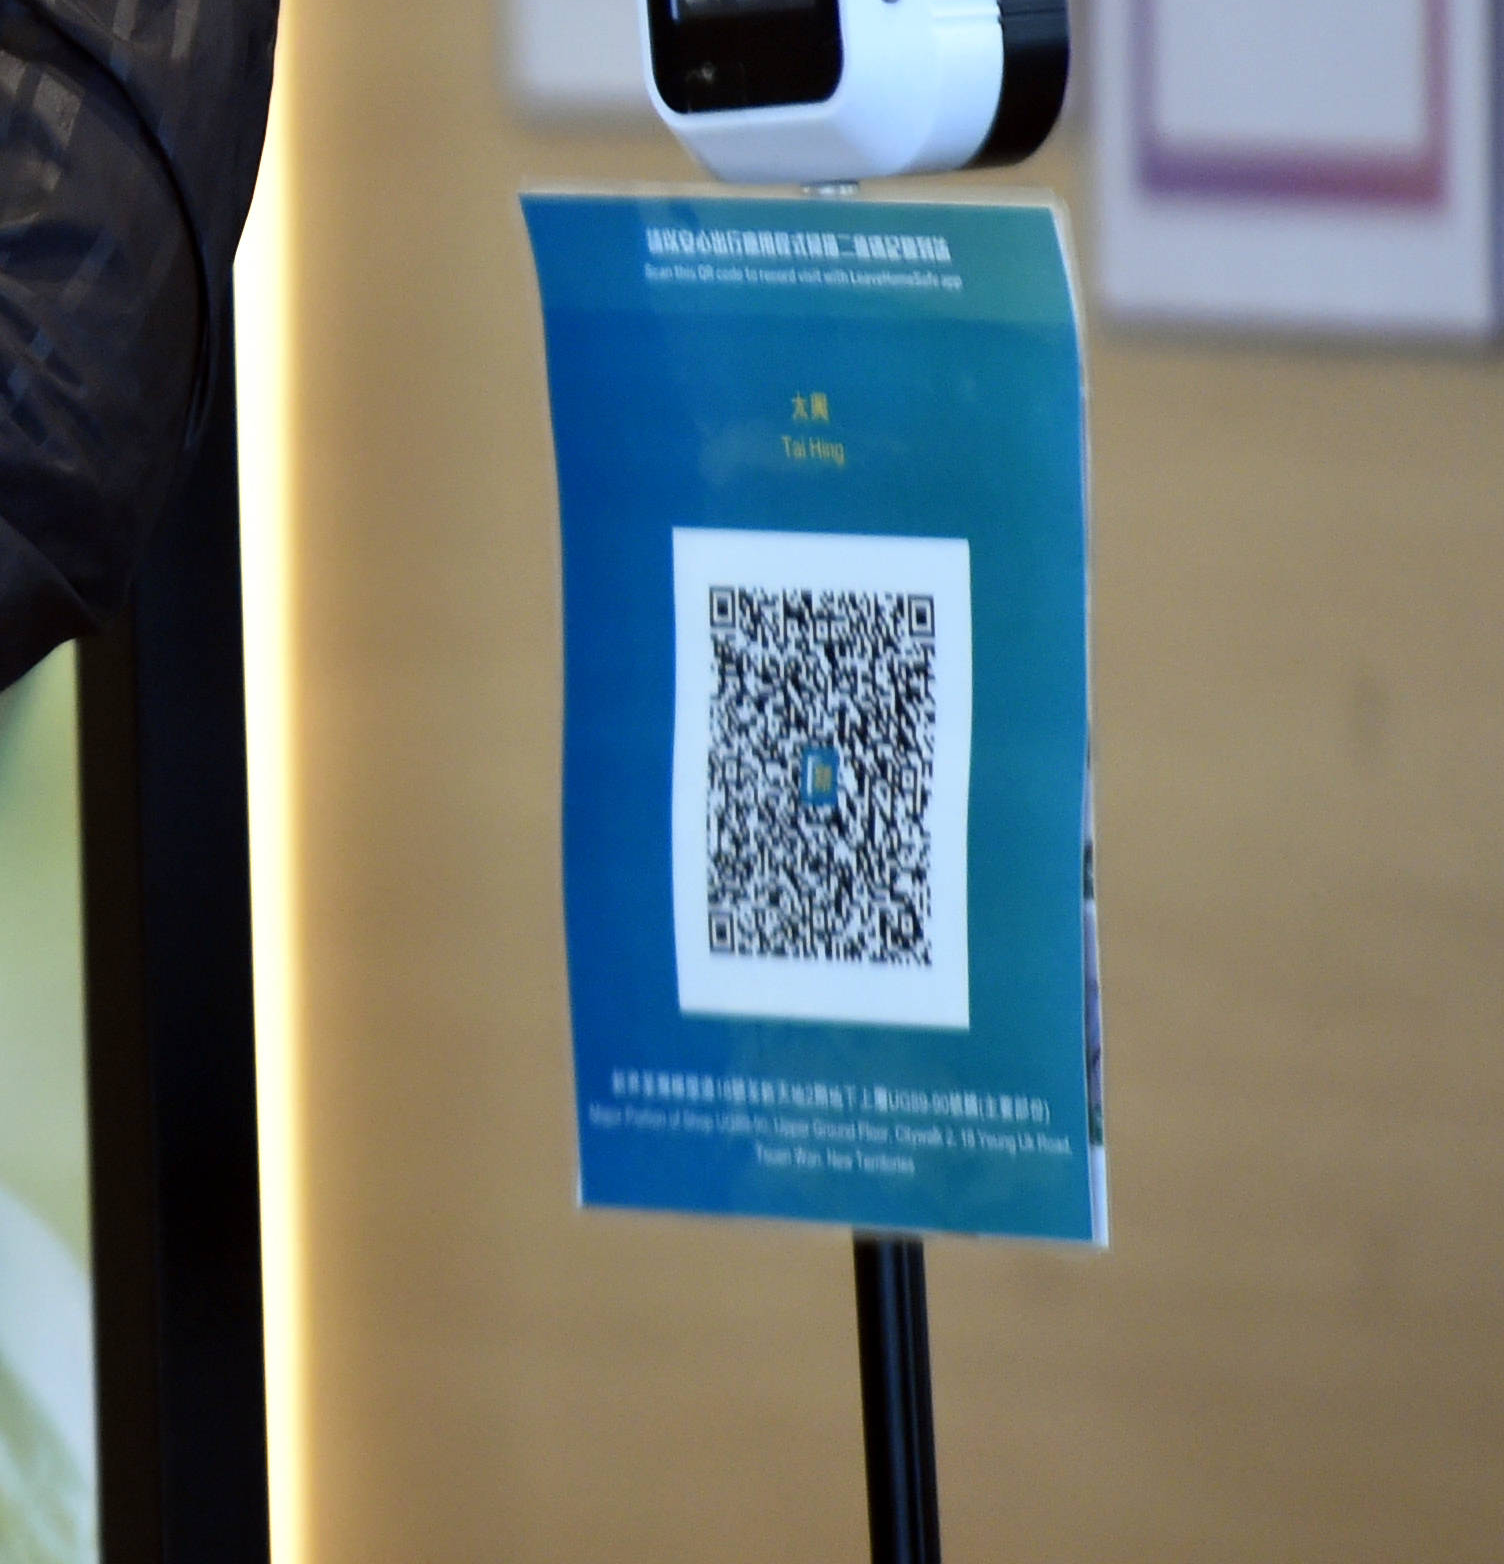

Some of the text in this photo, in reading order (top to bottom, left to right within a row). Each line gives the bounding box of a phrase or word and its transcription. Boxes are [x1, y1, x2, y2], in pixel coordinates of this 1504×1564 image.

[644, 262, 673, 280] Scan
[674, 263, 697, 281] this
[697, 263, 714, 282] QR
[716, 265, 744, 282] code
[744, 267, 758, 282] to
[781, 435, 845, 466] Tai Hing
